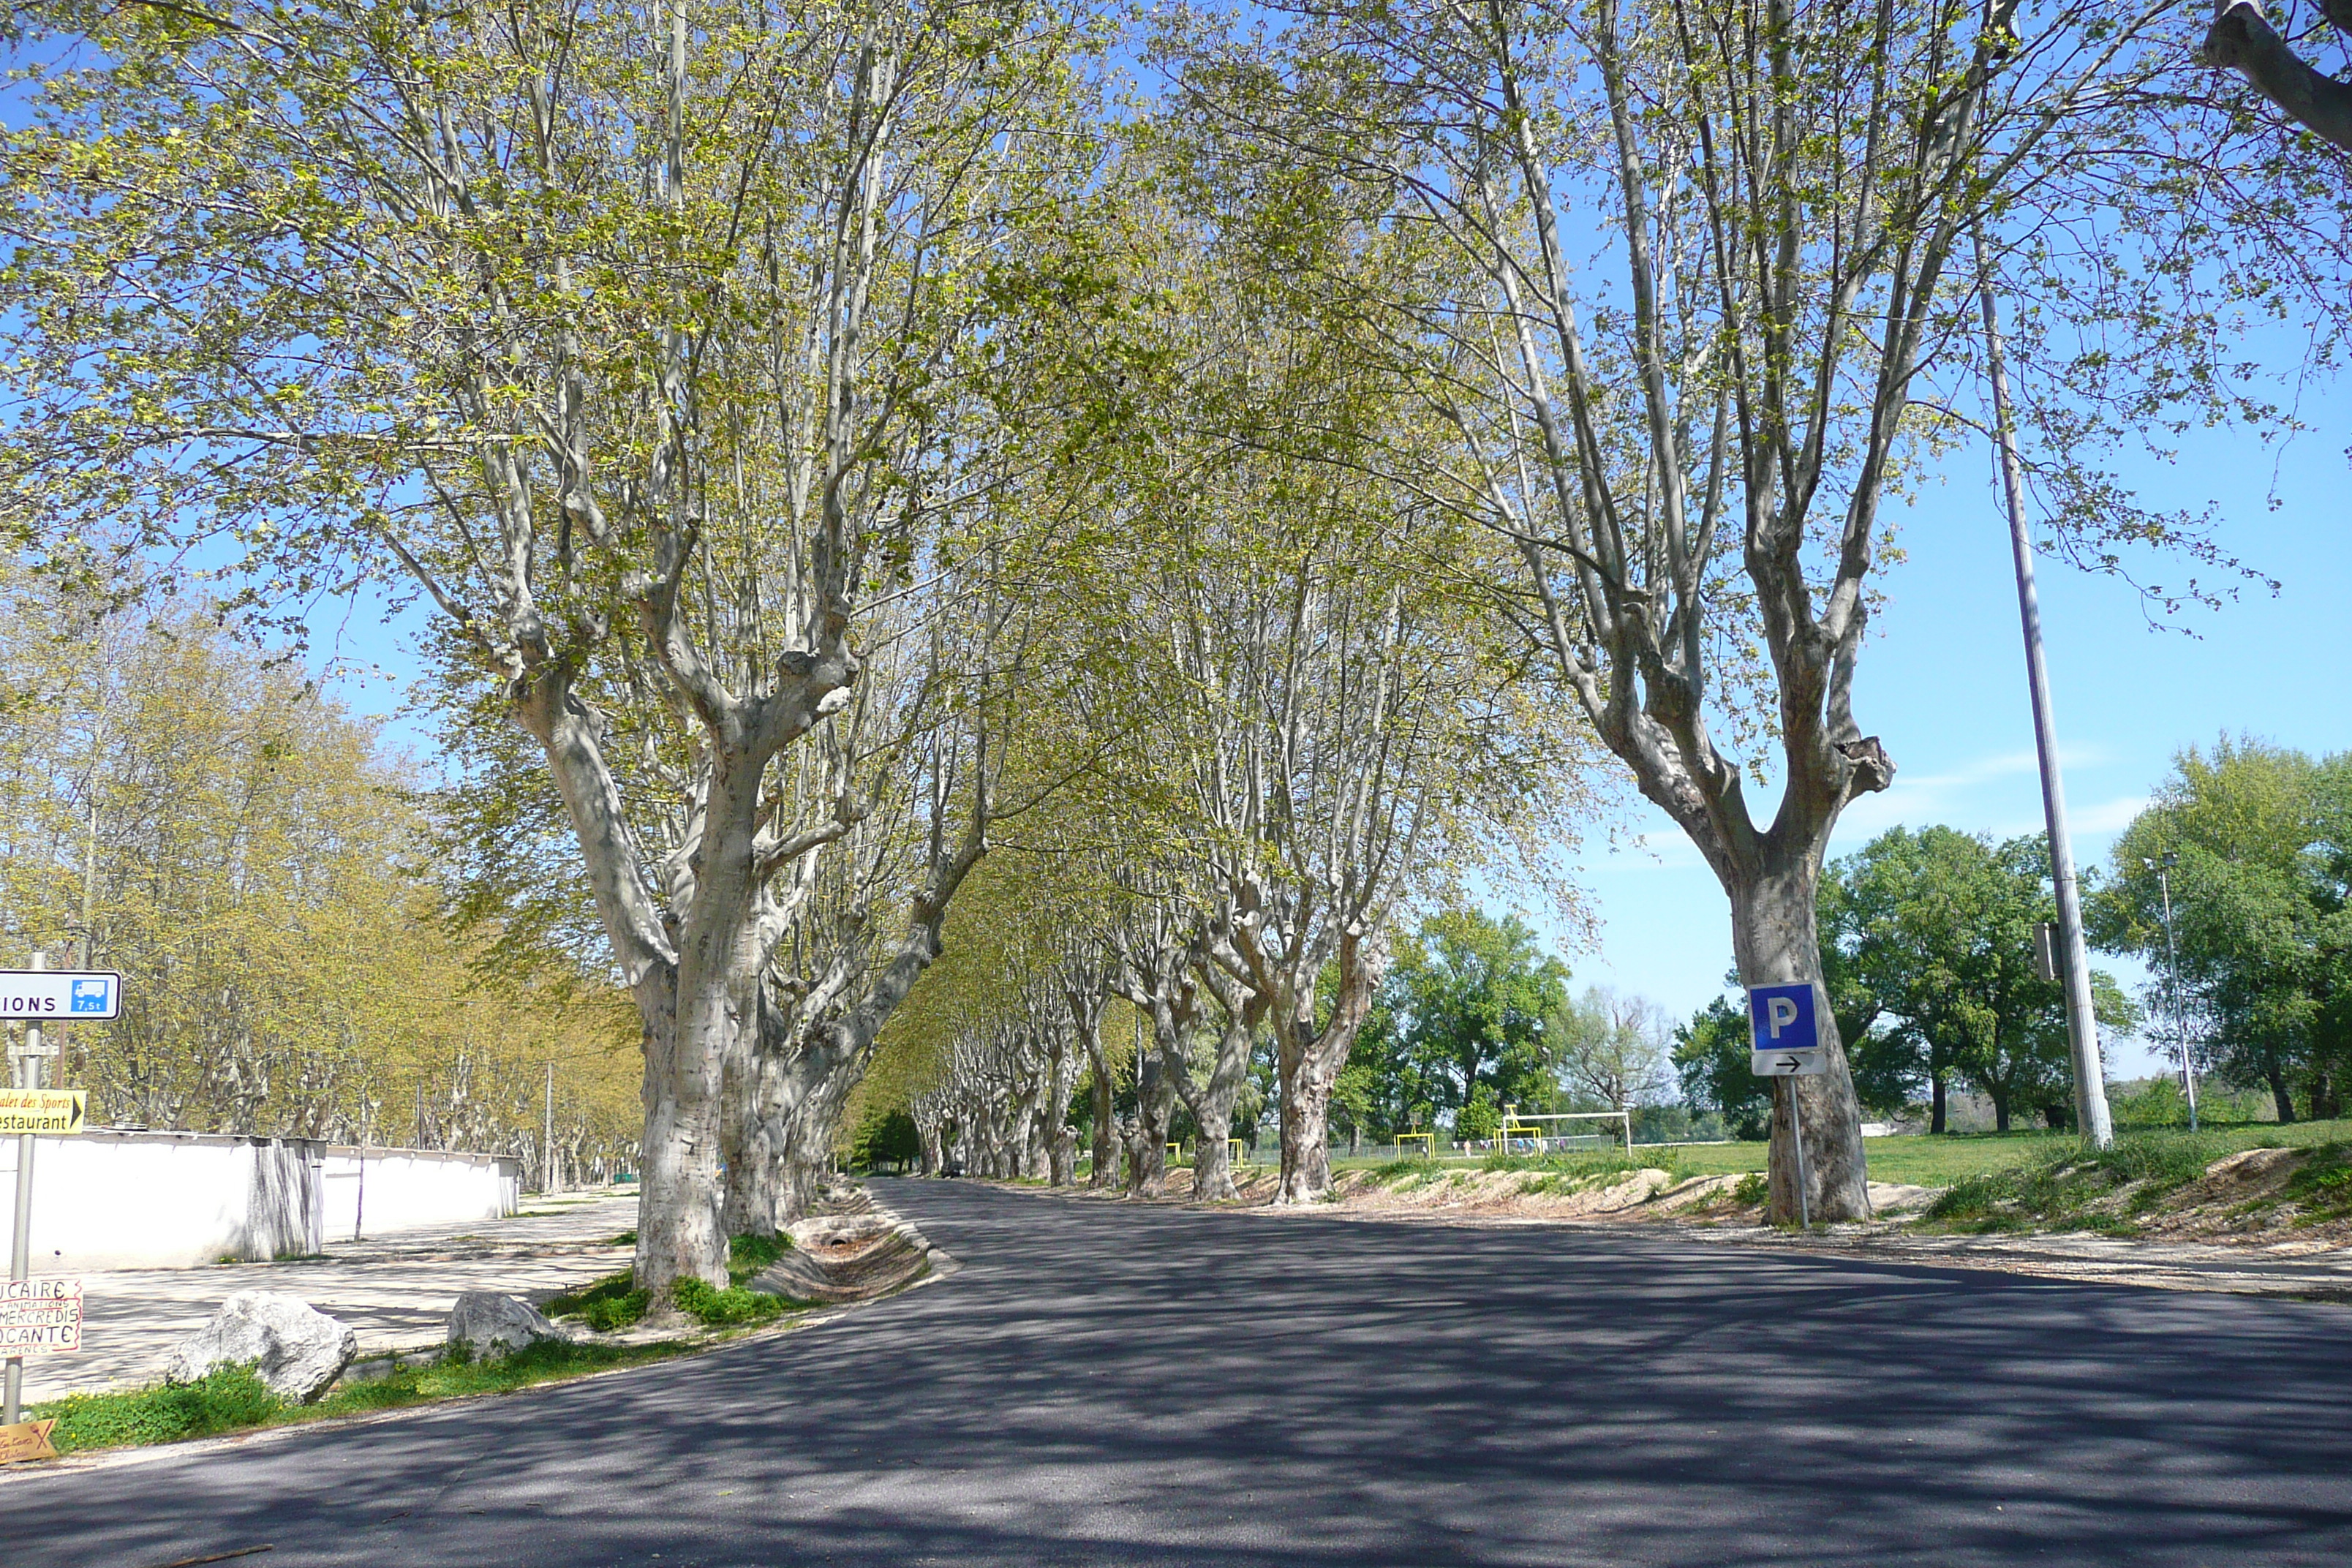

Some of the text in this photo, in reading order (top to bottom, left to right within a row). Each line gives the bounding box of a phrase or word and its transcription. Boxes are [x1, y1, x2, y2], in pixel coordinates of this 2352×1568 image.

[0, 997, 56, 1011] IONS
[1768, 997, 1798, 1039] P
[20, 1093, 37, 1108] des
[39, 1093, 70, 1114] Sports
